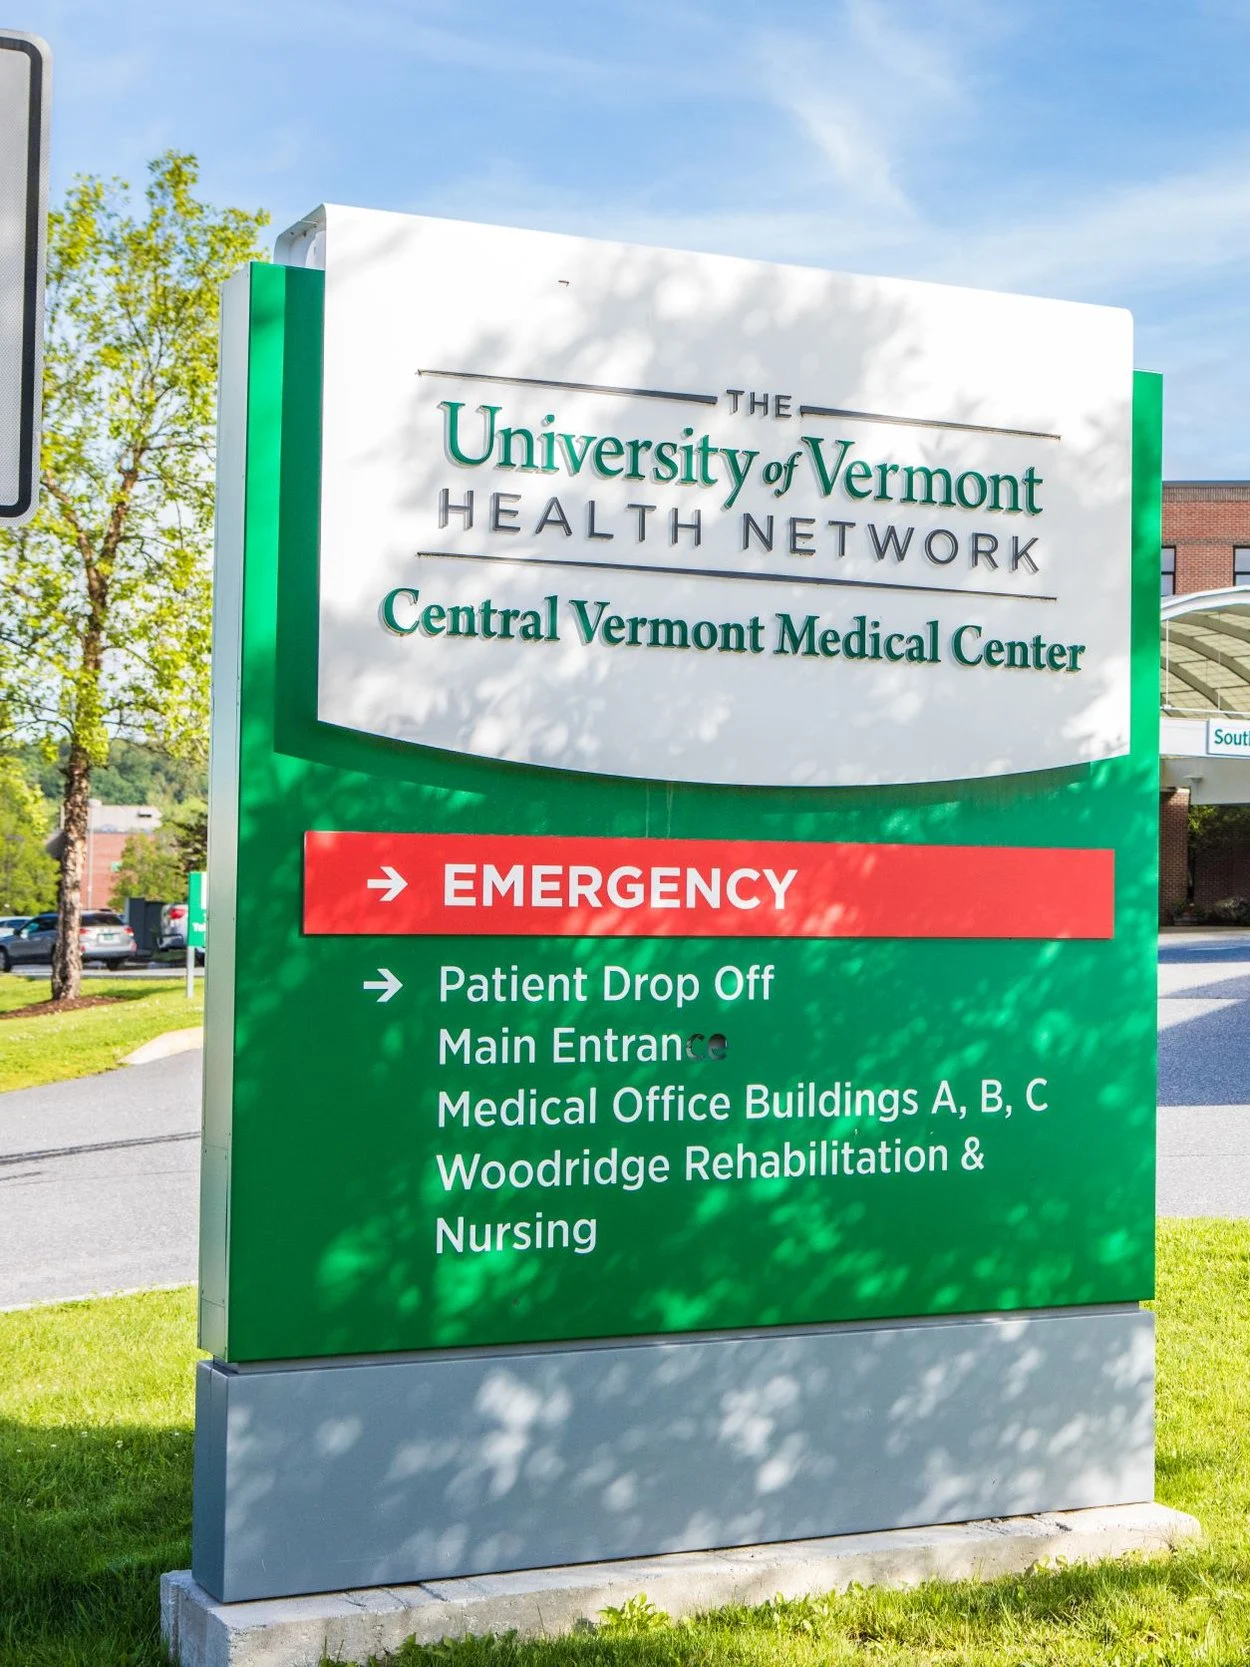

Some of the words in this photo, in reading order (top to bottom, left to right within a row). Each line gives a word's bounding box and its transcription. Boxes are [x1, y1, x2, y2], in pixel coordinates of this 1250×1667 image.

[725, 388, 793, 420] THE
[439, 400, 760, 510] University
[761, 450, 799, 498] of
[801, 435, 1044, 516] Vermont
[438, 487, 703, 547] HEALTH
[742, 511, 1042, 575] NETWORK
[381, 586, 560, 644] Central
[569, 599, 766, 654] Vermont
[773, 612, 942, 666] Medical
[951, 624, 1086, 674] Center
[444, 863, 798, 911] EMERGENCY
[439, 965, 588, 1003] Patient
[603, 965, 700, 1008] Drop
[714, 964, 775, 1001] Off
[439, 1027, 536, 1066] Main
[438, 1087, 597, 1127] Medical
[613, 1085, 731, 1123] Office
[746, 1081, 919, 1122] Buildings
[931, 1080, 968, 1120] A,
[980, 1079, 1013, 1117] B,
[1026, 1077, 1049, 1112] C
[436, 1147, 670, 1191] Woodridge
[685, 1138, 948, 1181] Rehabilitation
[960, 1137, 985, 1171] &
[436, 1212, 598, 1255] Nursing
